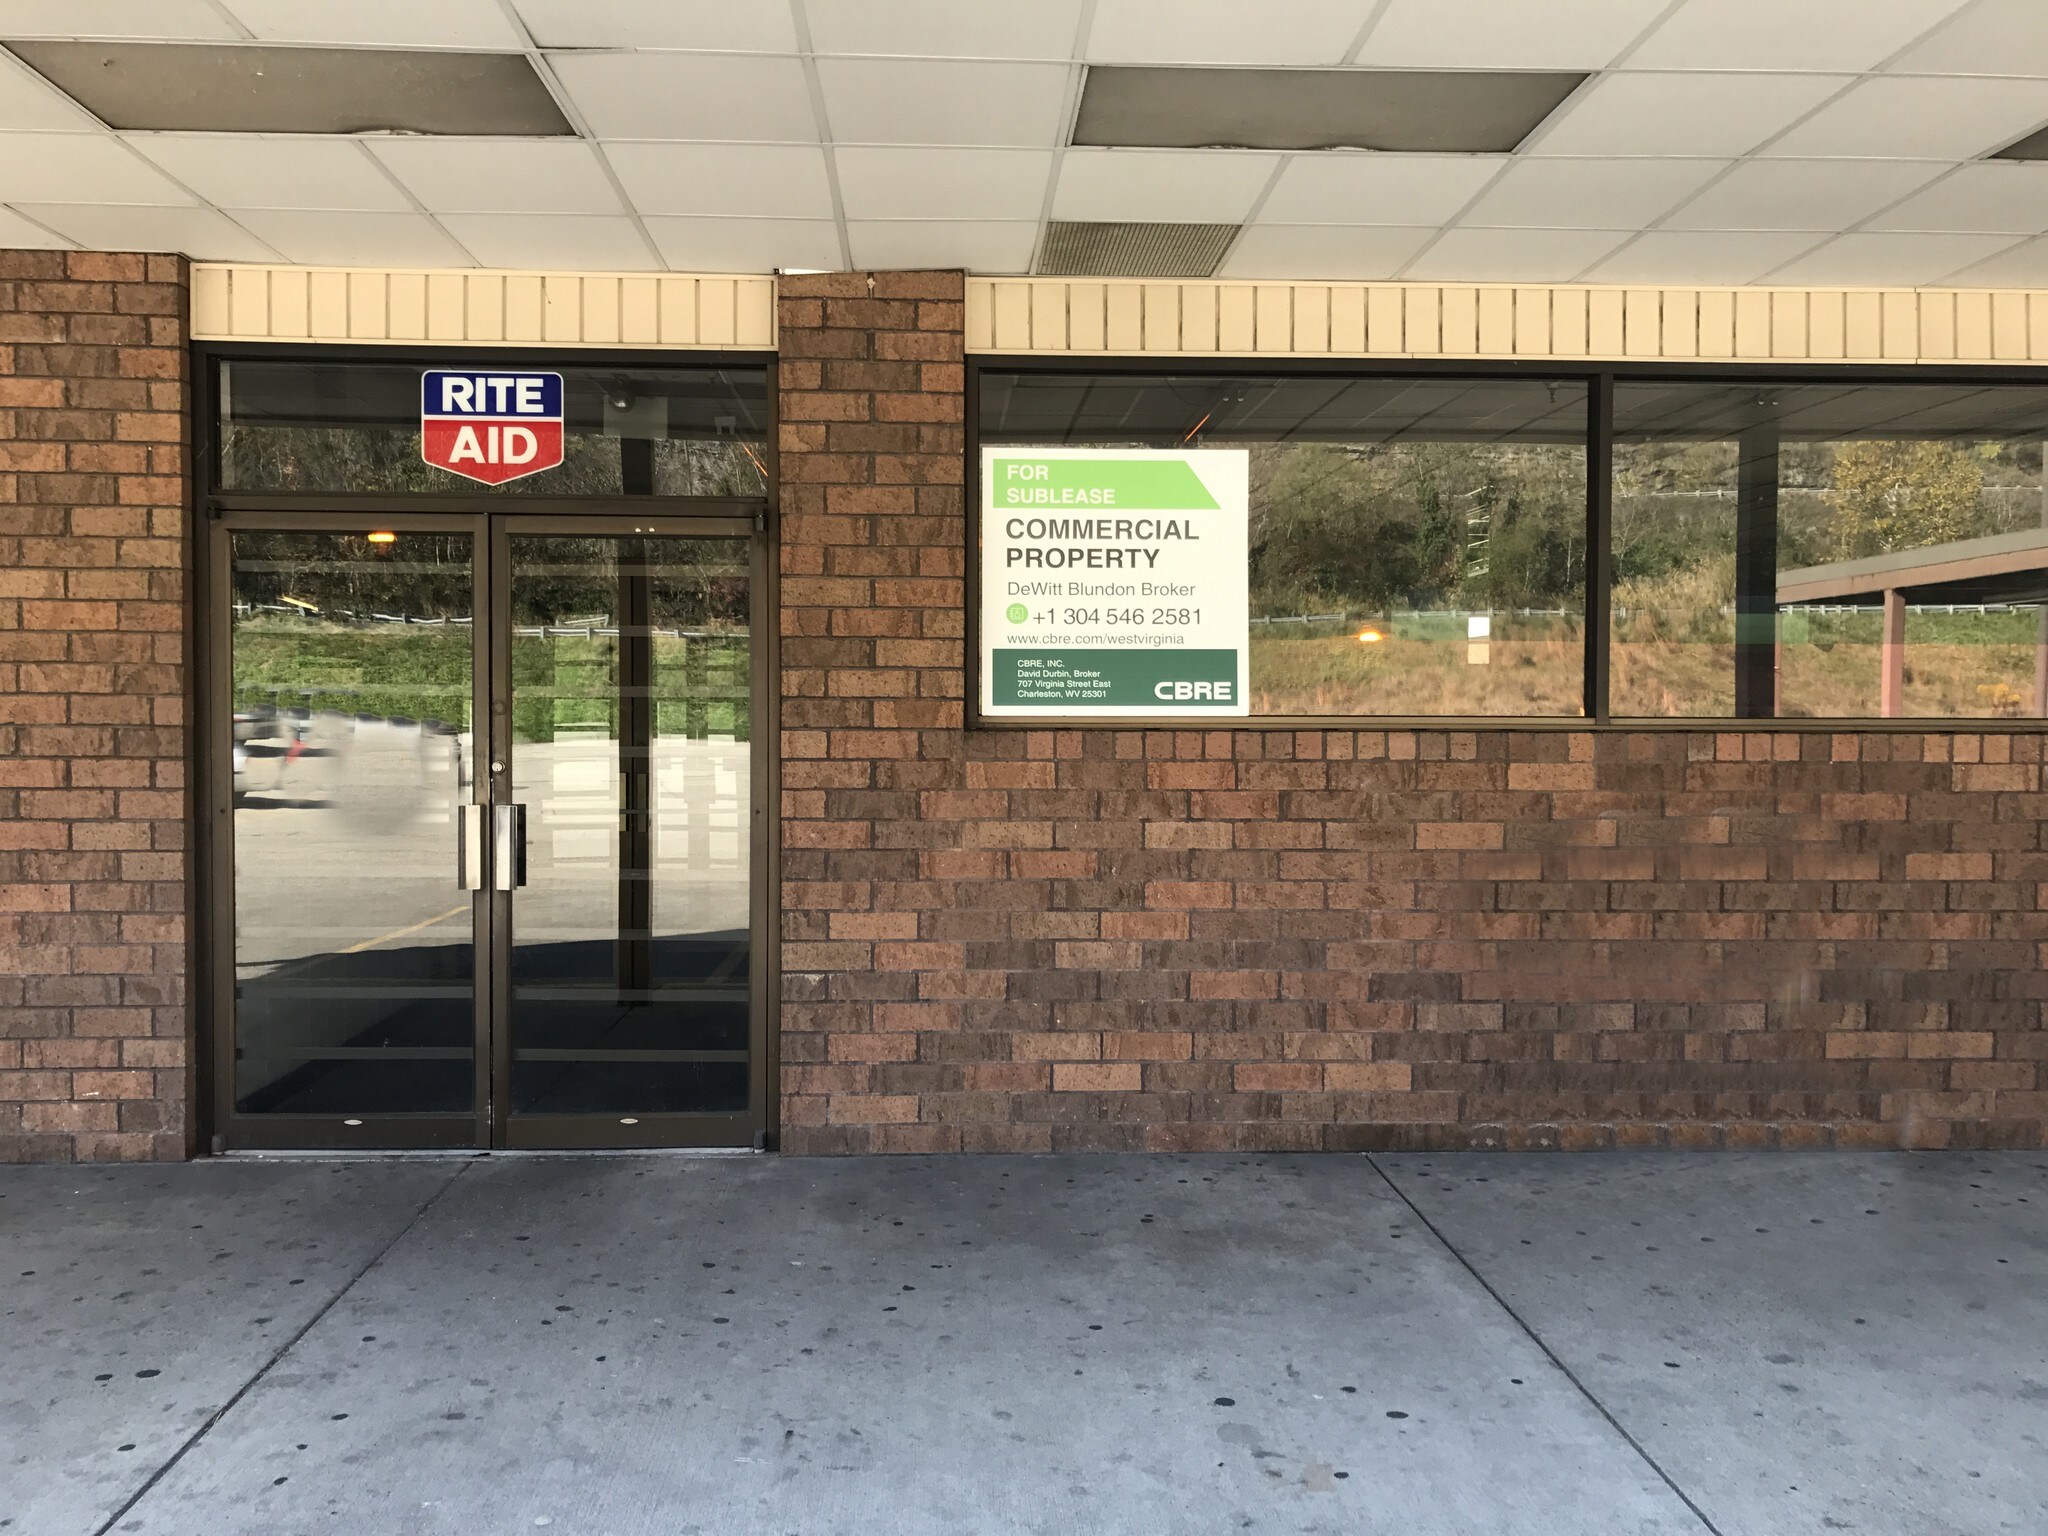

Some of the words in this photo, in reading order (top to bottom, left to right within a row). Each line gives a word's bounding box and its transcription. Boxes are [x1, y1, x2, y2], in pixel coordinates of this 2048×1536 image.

[441, 376, 544, 413] RITE
[448, 426, 539, 465] AID
[1006, 464, 1049, 481] FOR
[1006, 488, 1116, 504] SUBLEASE
[1006, 518, 1200, 540] COMMERCIAL
[1006, 548, 1160, 569] PROPERTY
[1007, 581, 1063, 596] DeWitt
[1068, 582, 1135, 596] Blundon
[1141, 582, 1196, 596] Broker
[1032, 608, 1055, 625] +1
[1063, 608, 1100, 625] 304
[1106, 608, 1144, 625] 546
[1152, 608, 1201, 625] 2581
[1006, 633, 1184, 646] www.cbre.com/westvirginia
[1017, 659, 1044, 668] CBRE,
[1017, 670, 1040, 678] David
[1043, 670, 1071, 679] Durbin,
[1073, 670, 1101, 678] Broker
[1017, 680, 1032, 688] 707
[1035, 680, 1064, 690] Virginia
[1067, 680, 1091, 688] Street
[1093, 680, 1111, 688] East
[1154, 681, 1232, 700] CBRE
[1017, 689, 1063, 699] Charleston,
[1065, 690, 1080, 698] WV
[1082, 690, 1106, 698] 25301
